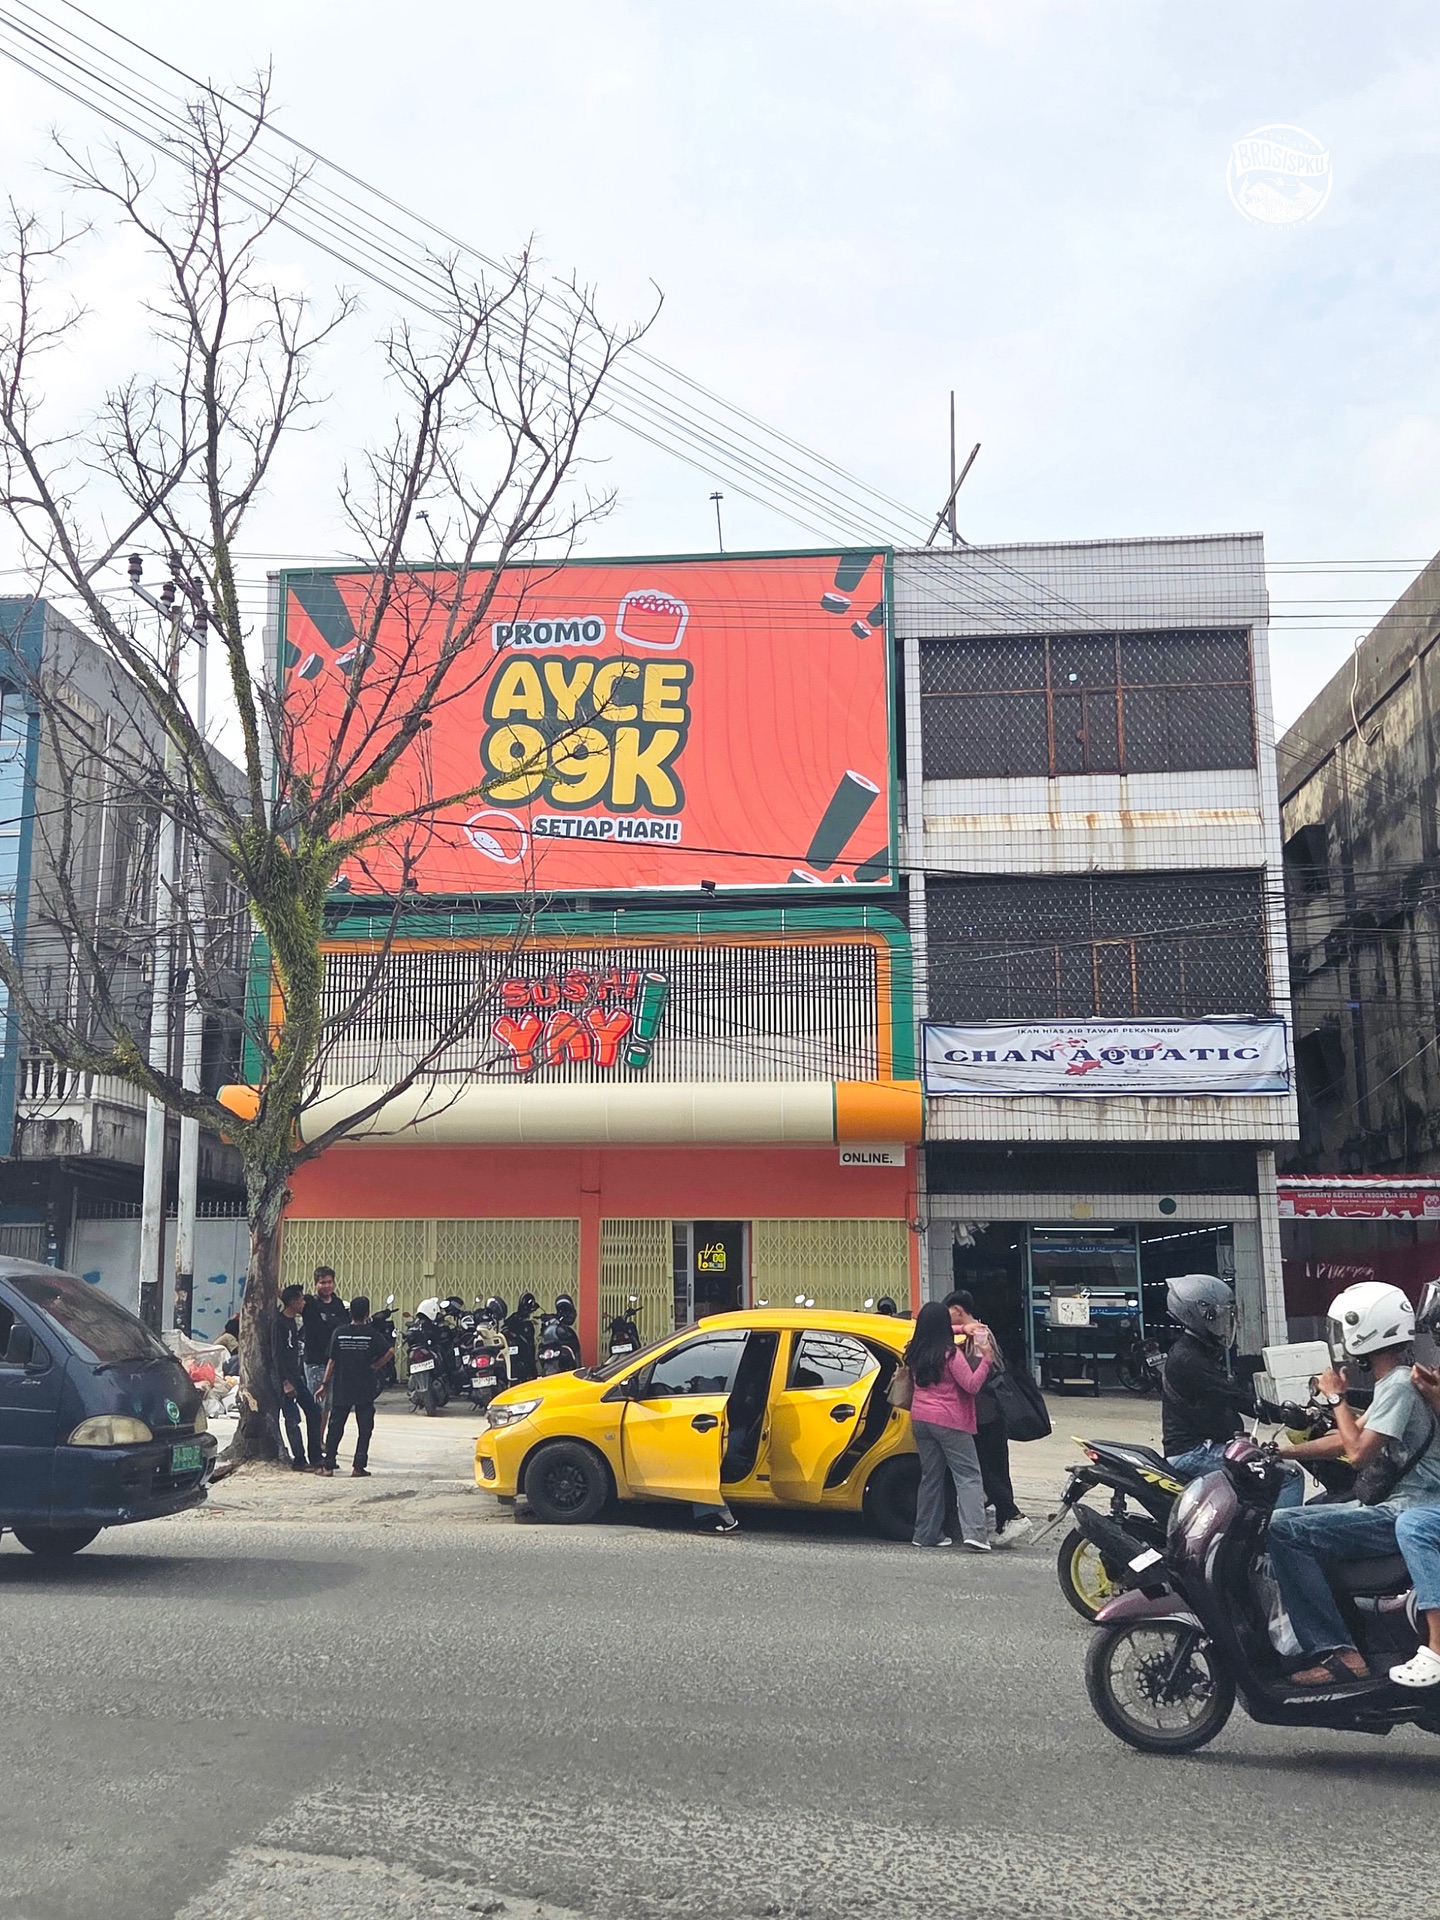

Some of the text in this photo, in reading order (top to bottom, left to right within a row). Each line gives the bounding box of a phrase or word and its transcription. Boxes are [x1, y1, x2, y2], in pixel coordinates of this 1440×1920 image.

[495, 618, 603, 646] PROMO
[488, 657, 690, 724] AYCE
[485, 722, 684, 810] 99K
[535, 818, 680, 841] SETIAP HARI!
[501, 966, 639, 1007] SUSHI
[944, 1046, 1260, 1065] CHAN AQUATIC
[842, 1152, 893, 1164] ONLINE.
